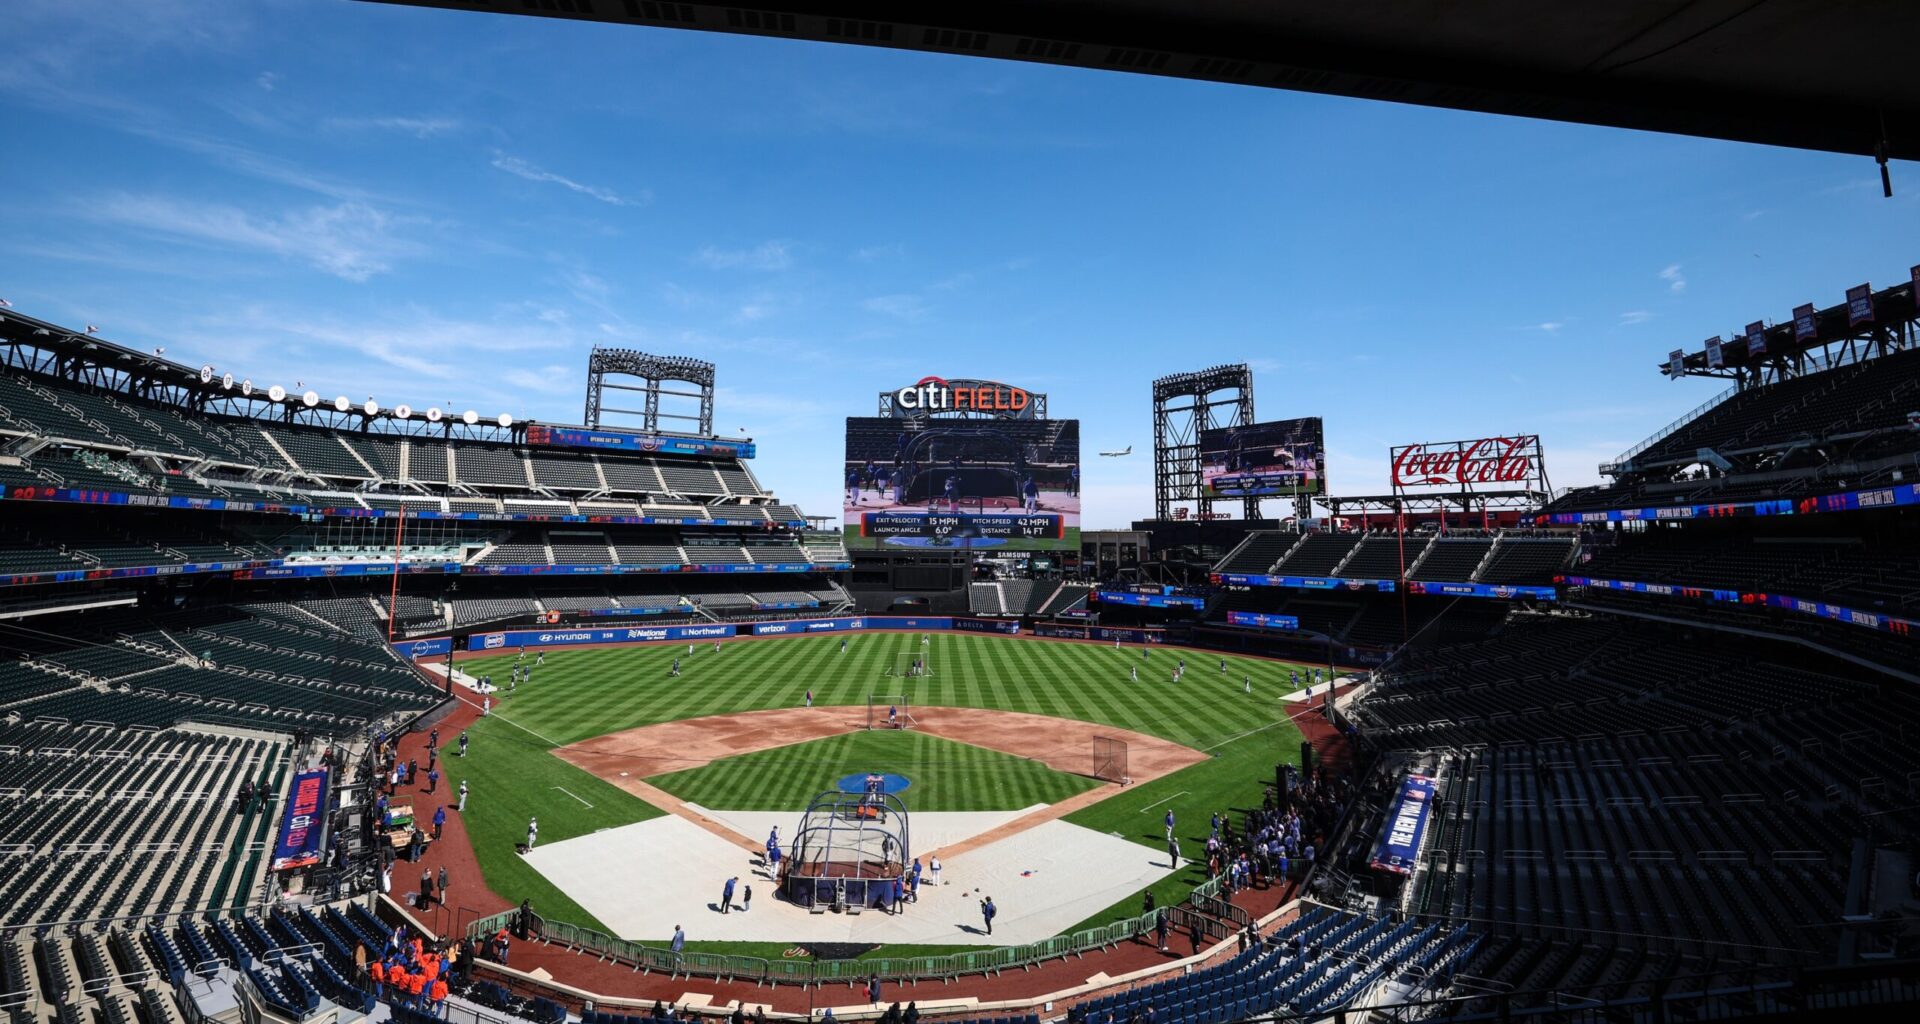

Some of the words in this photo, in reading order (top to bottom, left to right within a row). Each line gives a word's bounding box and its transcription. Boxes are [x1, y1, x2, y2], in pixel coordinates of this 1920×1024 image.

[898, 382, 947, 409] citi
[954, 387, 1028, 411] FIELD
[1392, 435, 1538, 486] Coca-Cola
[128, 494, 148, 506] OPENING
[929, 517, 937, 525] 15
[939, 517, 958, 526] MPH
[1018, 518, 1029, 526] 42
[1030, 518, 1048, 526] MPH
[935, 526, 952, 534] 6.0°
[1023, 527, 1031, 535] 14
[1033, 527, 1043, 535] FT
[636, 629, 667, 637] National
[759, 625, 786, 633] verizon
[294, 777, 321, 807] WELCOME
[292, 806, 317, 816] TO
[1399, 799, 1423, 817] YORK
[290, 815, 314, 830] citi
[1393, 815, 1418, 834] NEW
[286, 828, 308, 847] FIELD
[1387, 830, 1413, 847] THE
